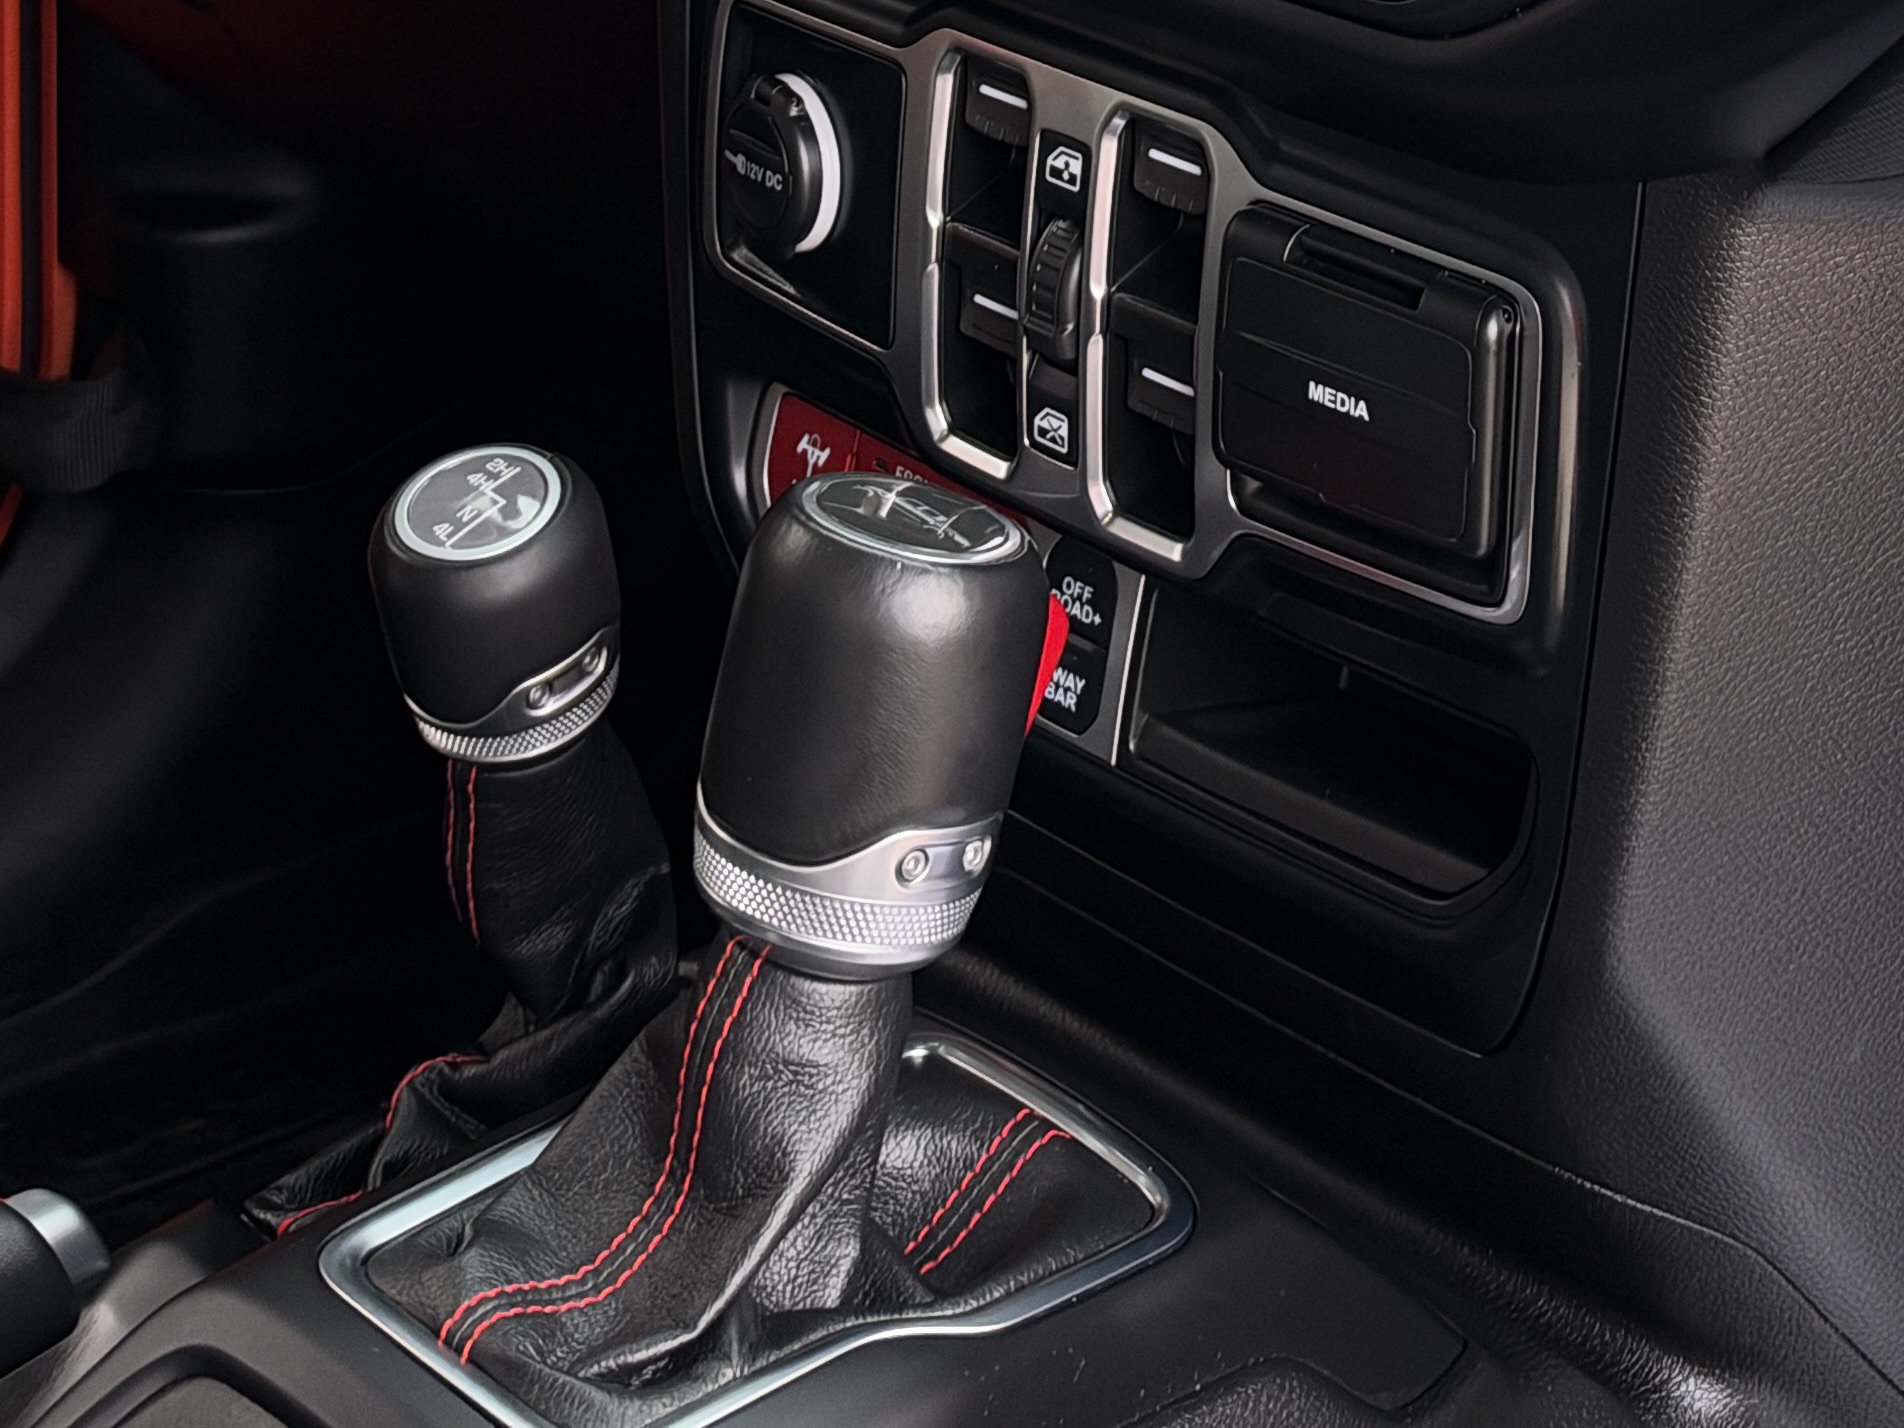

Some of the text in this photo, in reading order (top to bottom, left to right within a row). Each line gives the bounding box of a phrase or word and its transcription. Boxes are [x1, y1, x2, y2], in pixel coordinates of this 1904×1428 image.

[746, 161, 783, 191] 12V DC
[1308, 379, 1370, 422] MEDIA
[485, 458, 512, 476] 2H
[466, 472, 495, 490] 4H
[456, 505, 477, 522] N
[432, 522, 456, 541] 4L
[1062, 576, 1094, 603] OFF
[1053, 667, 1086, 695] WAY
[1044, 682, 1077, 713] BAR
